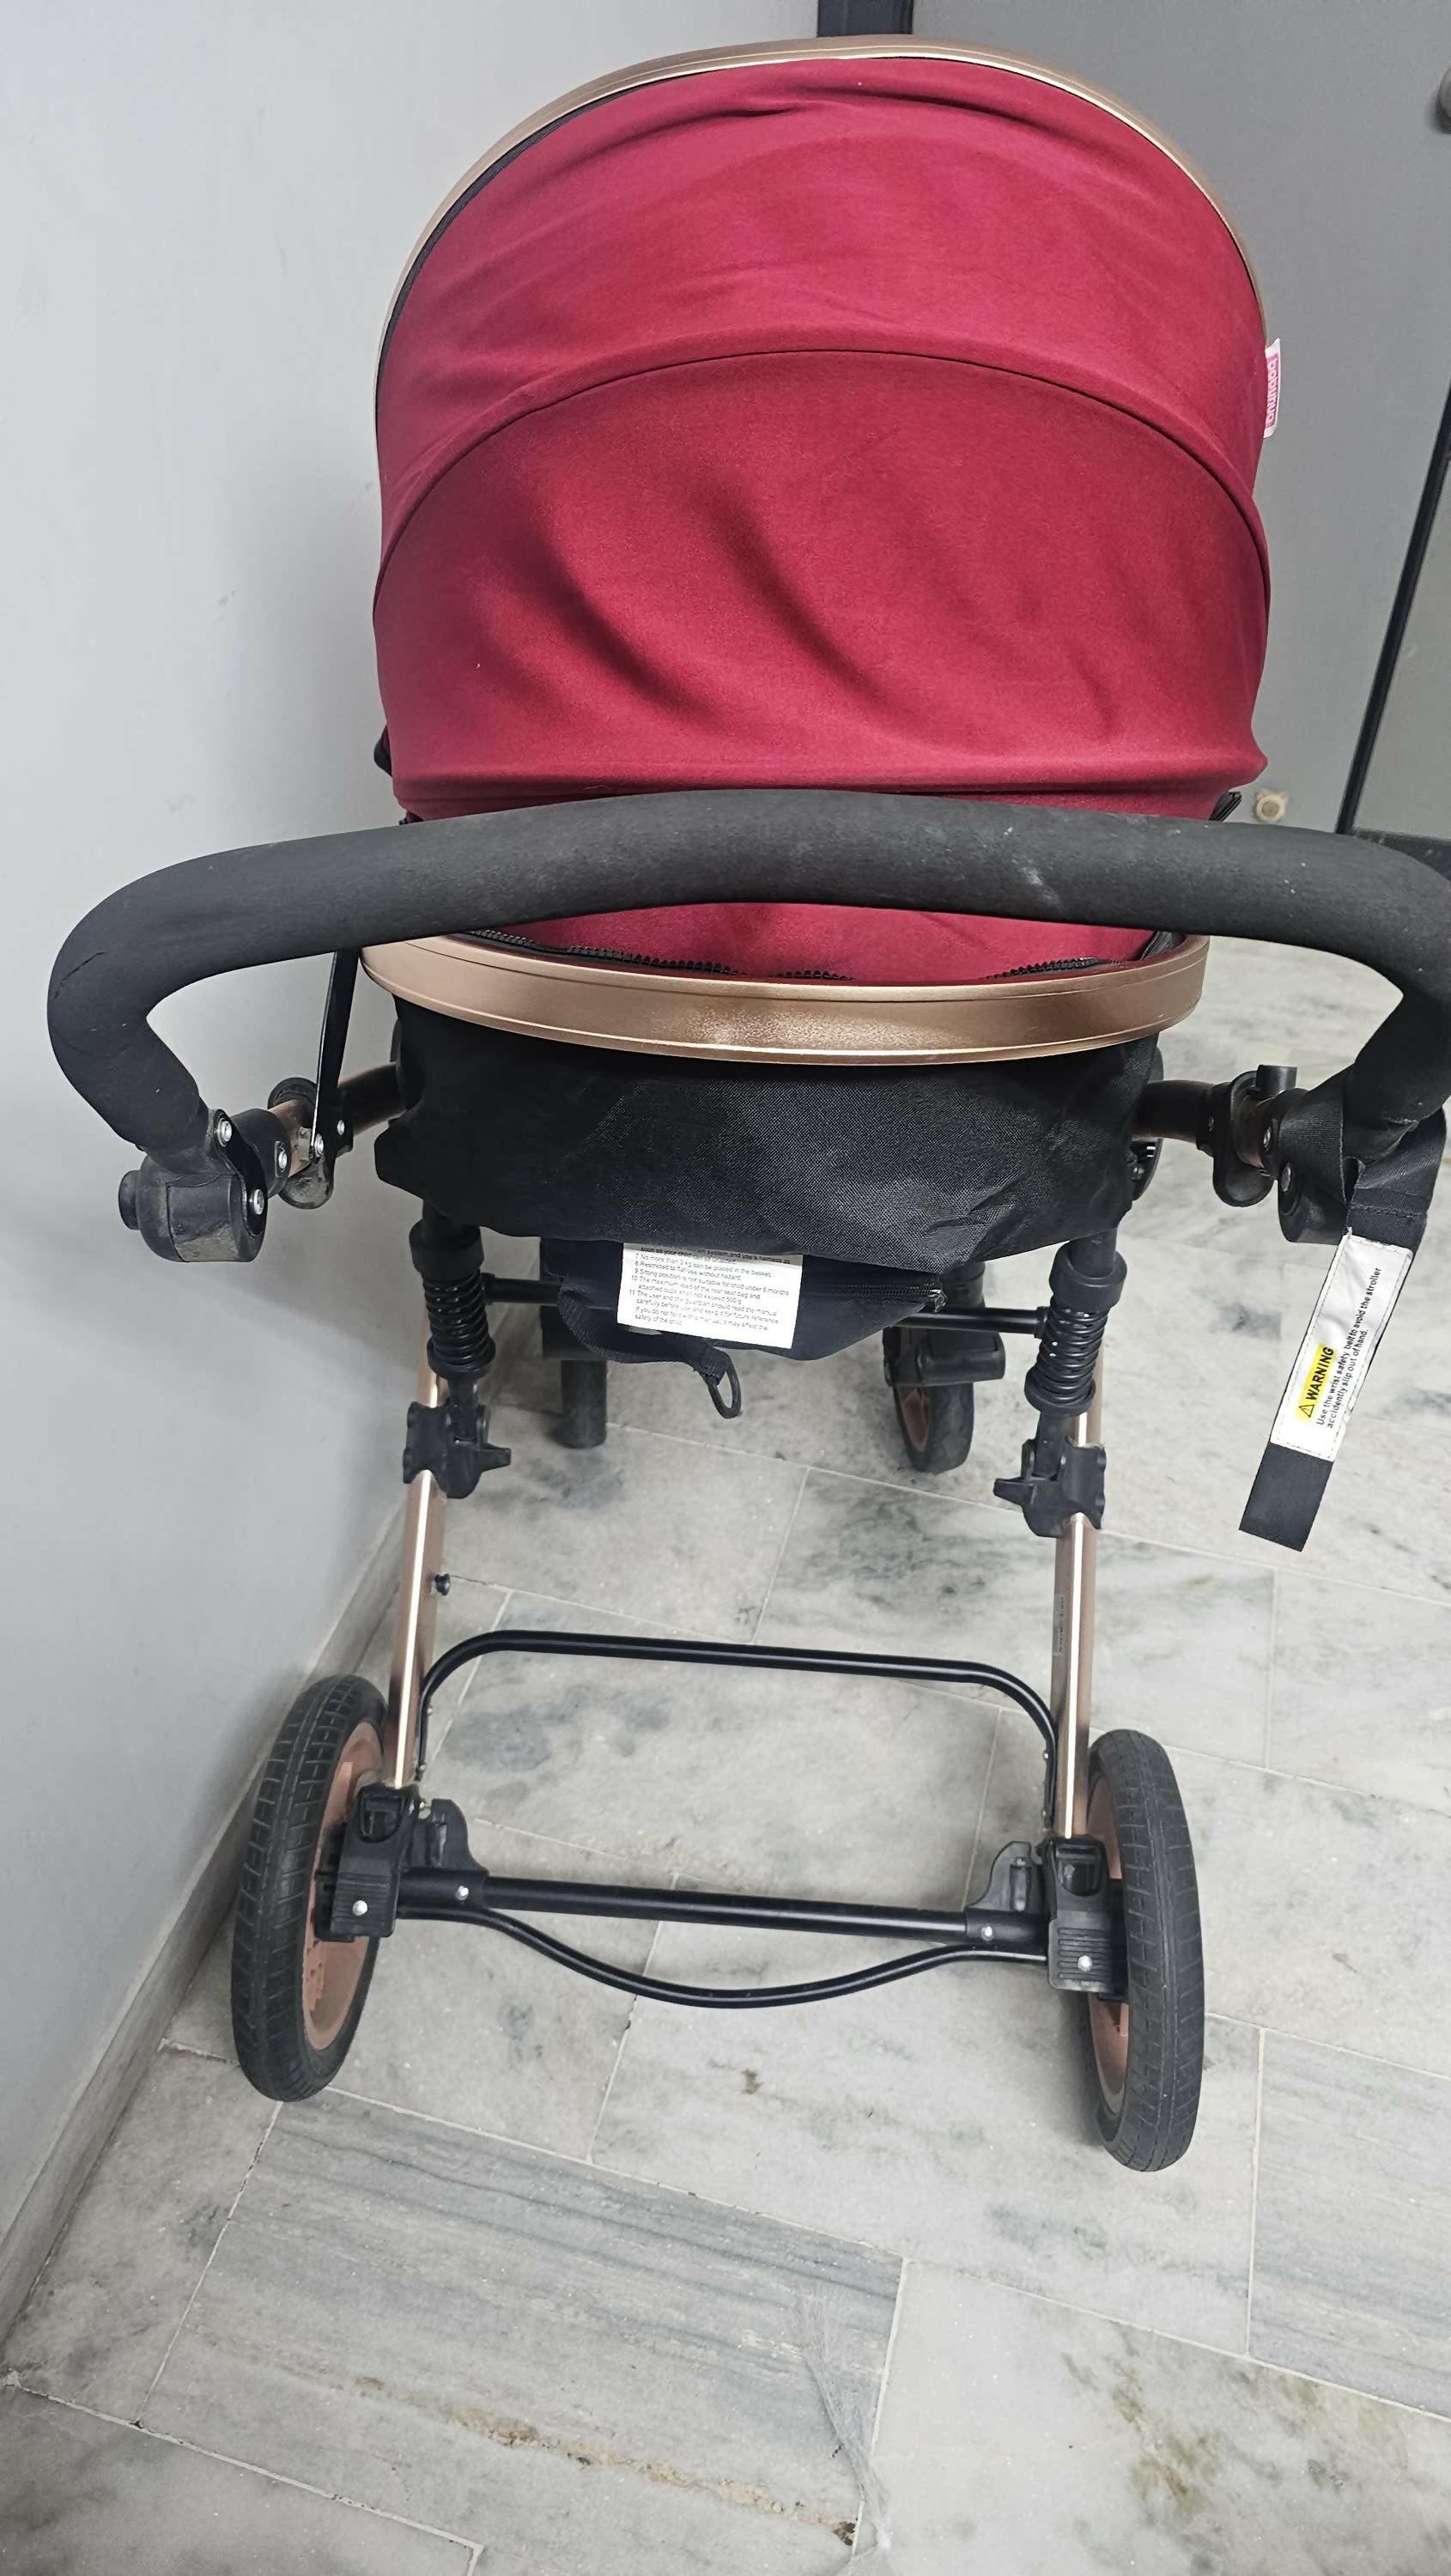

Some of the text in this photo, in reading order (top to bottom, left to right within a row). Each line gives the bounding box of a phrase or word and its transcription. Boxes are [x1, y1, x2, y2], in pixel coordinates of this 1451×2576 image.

[1305, 1346, 1334, 1400] WARNING
[1316, 1267, 1381, 1425] Use the wrist safety belt to avoid the stroller
[1327, 1388, 1348, 1428] accidently
[1342, 1371, 1354, 1387] slip
[1353, 1347, 1360, 1357] of
[1357, 1329, 1369, 1348] hand.
